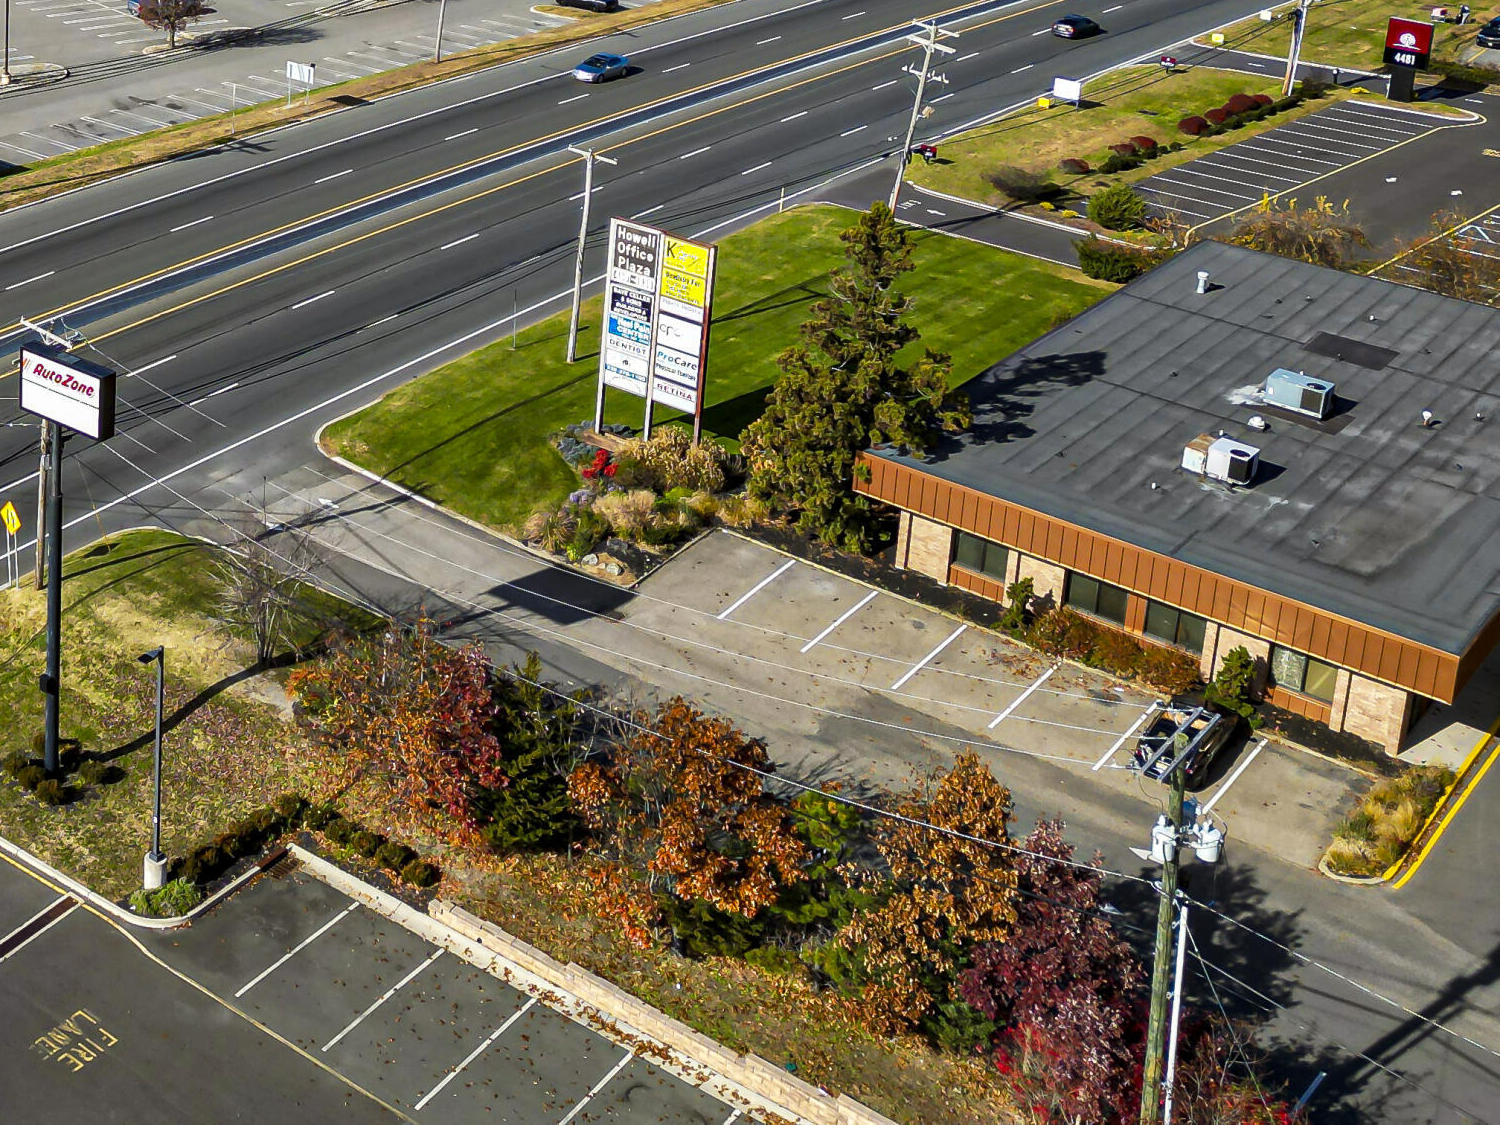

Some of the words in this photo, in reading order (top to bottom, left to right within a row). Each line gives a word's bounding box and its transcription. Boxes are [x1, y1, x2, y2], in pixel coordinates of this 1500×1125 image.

[1394, 52, 1416, 66] 4481
[618, 225, 656, 249] Howell
[617, 241, 654, 263] Office
[618, 255, 651, 277] Plaza
[657, 350, 698, 371] ProCare
[33, 363, 95, 397] AutoZone
[657, 383, 693, 400] RETINA
[33, 1009, 98, 1056] LANE
[58, 1027, 118, 1072] FIRE
